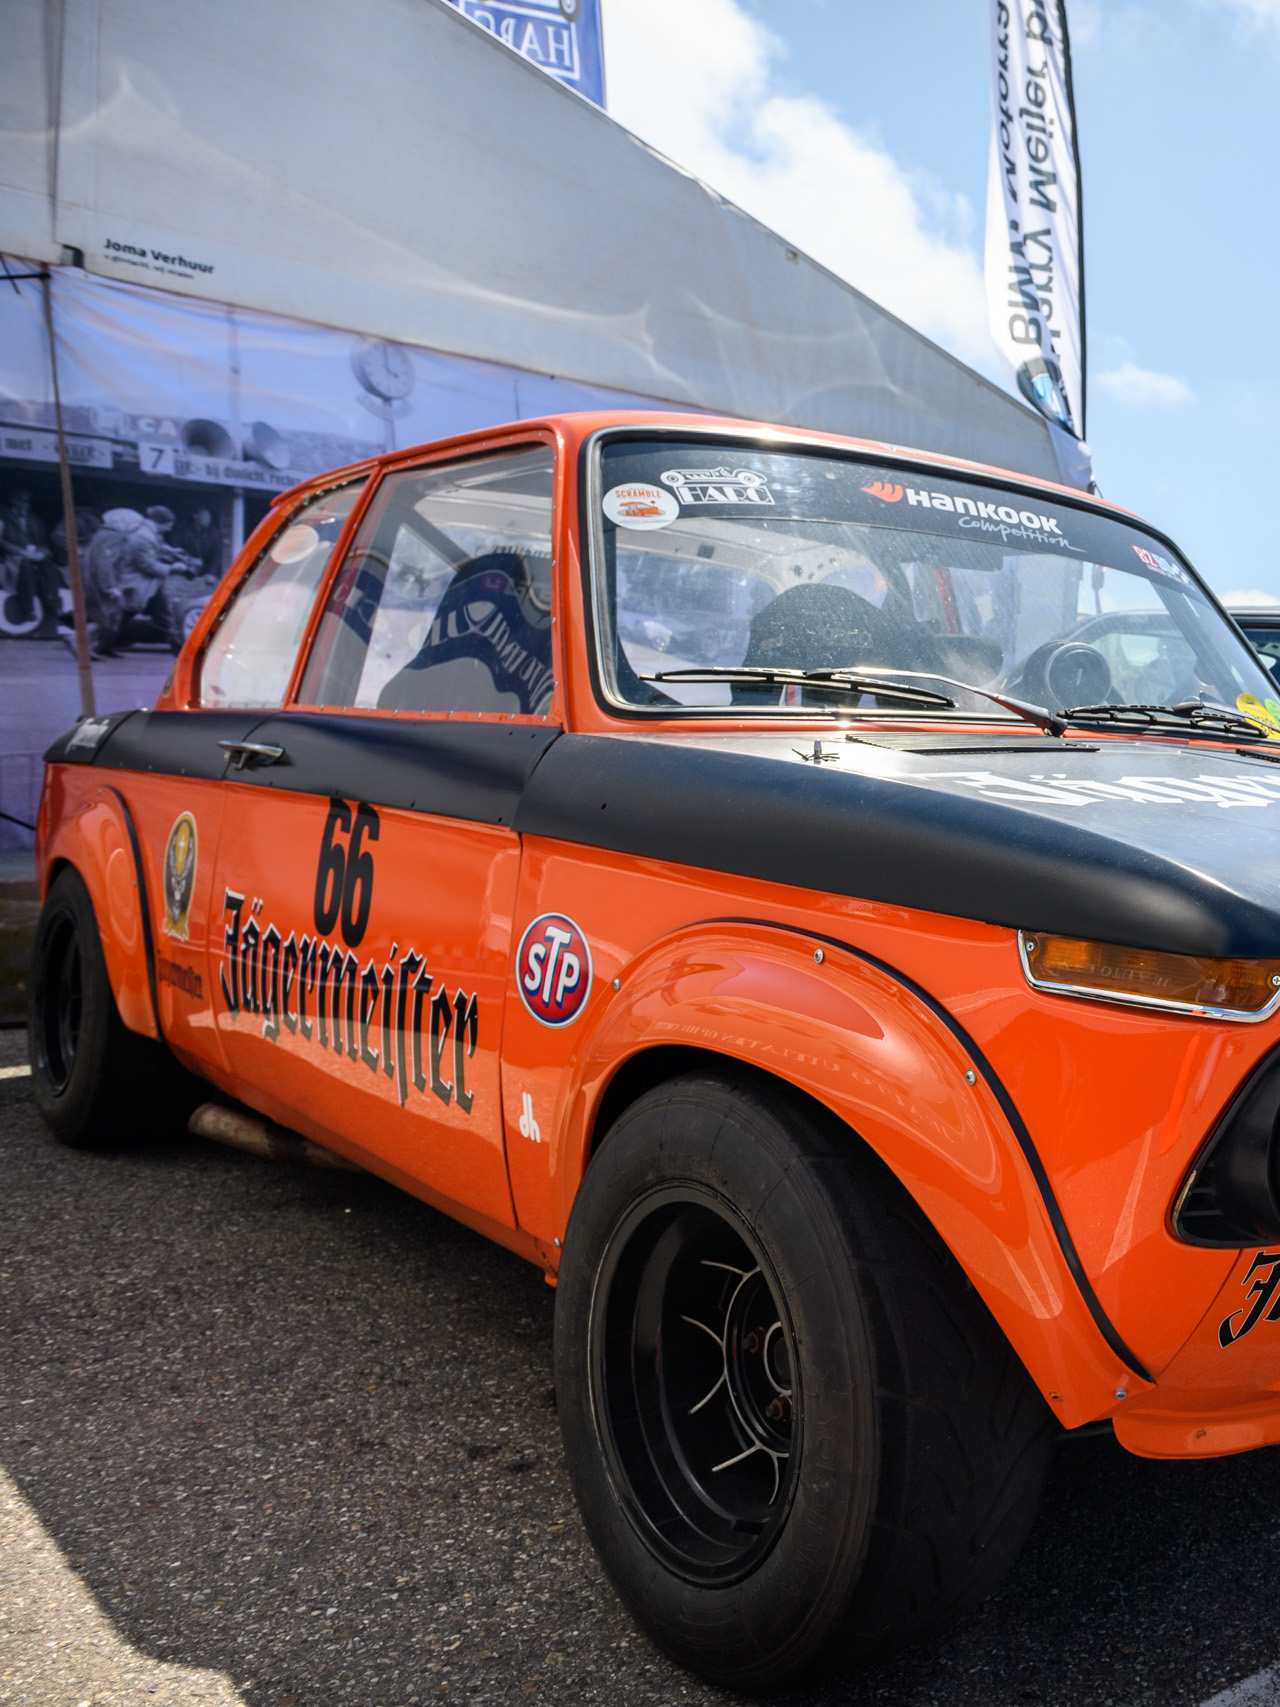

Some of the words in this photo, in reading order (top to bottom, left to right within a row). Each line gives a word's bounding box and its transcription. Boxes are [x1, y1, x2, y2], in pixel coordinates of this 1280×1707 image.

[104, 238, 147, 257] Joma
[151, 249, 215, 273] Verhuur
[150, 447, 164, 469] 7
[615, 489, 661, 499] SCRAMBLE
[683, 486, 770, 502] HARC
[314, 797, 380, 947] 66
[523, 925, 581, 1004] STP
[519, 1092, 541, 1143] dh
